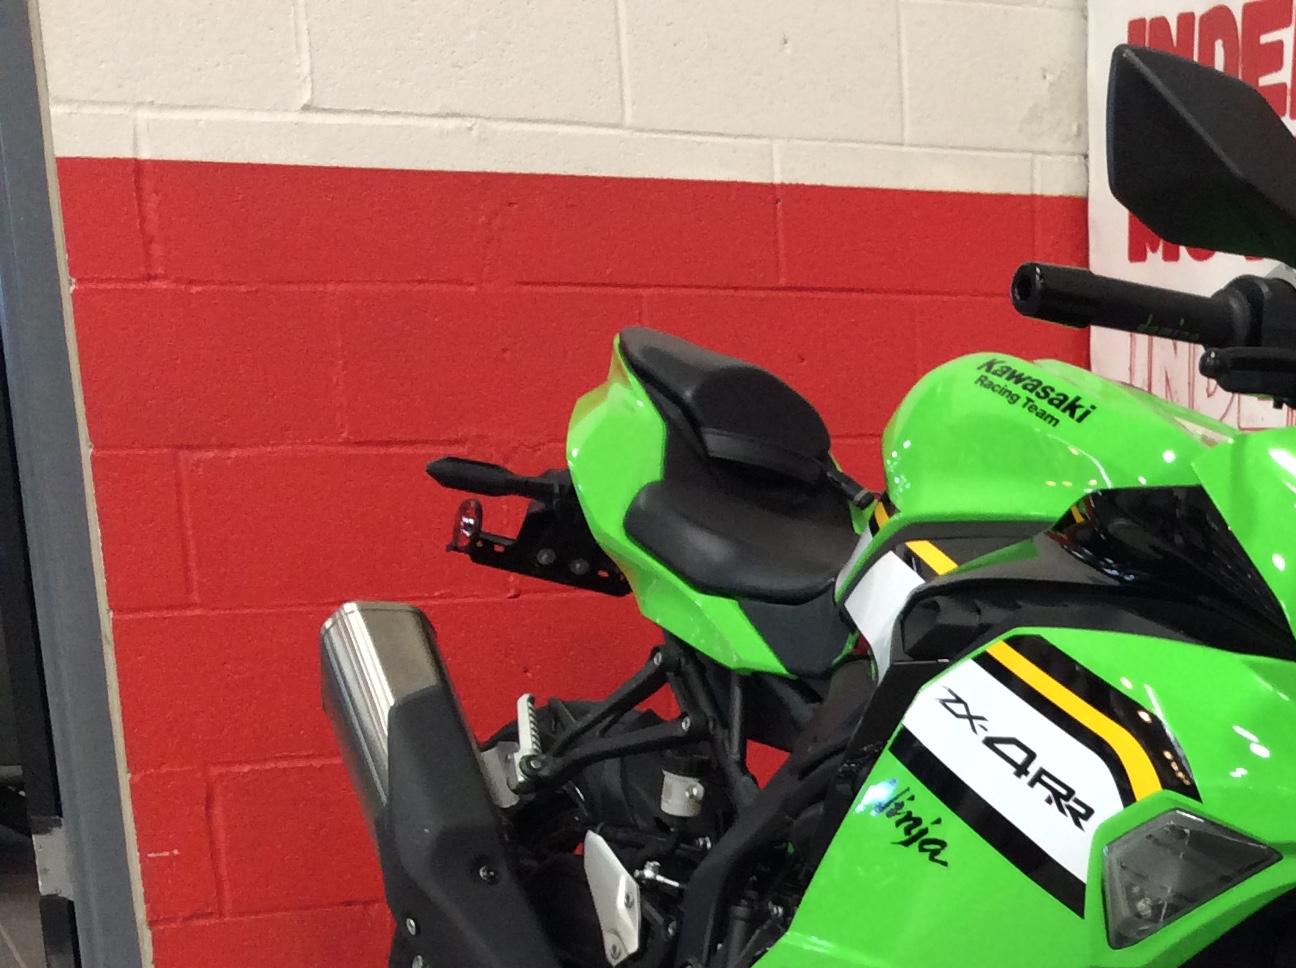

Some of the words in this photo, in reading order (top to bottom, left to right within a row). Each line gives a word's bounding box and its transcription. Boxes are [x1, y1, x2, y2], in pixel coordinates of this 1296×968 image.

[974, 374, 1021, 405] Racing
[1022, 396, 1060, 428] Team
[976, 358, 1097, 424] Kawasaki
